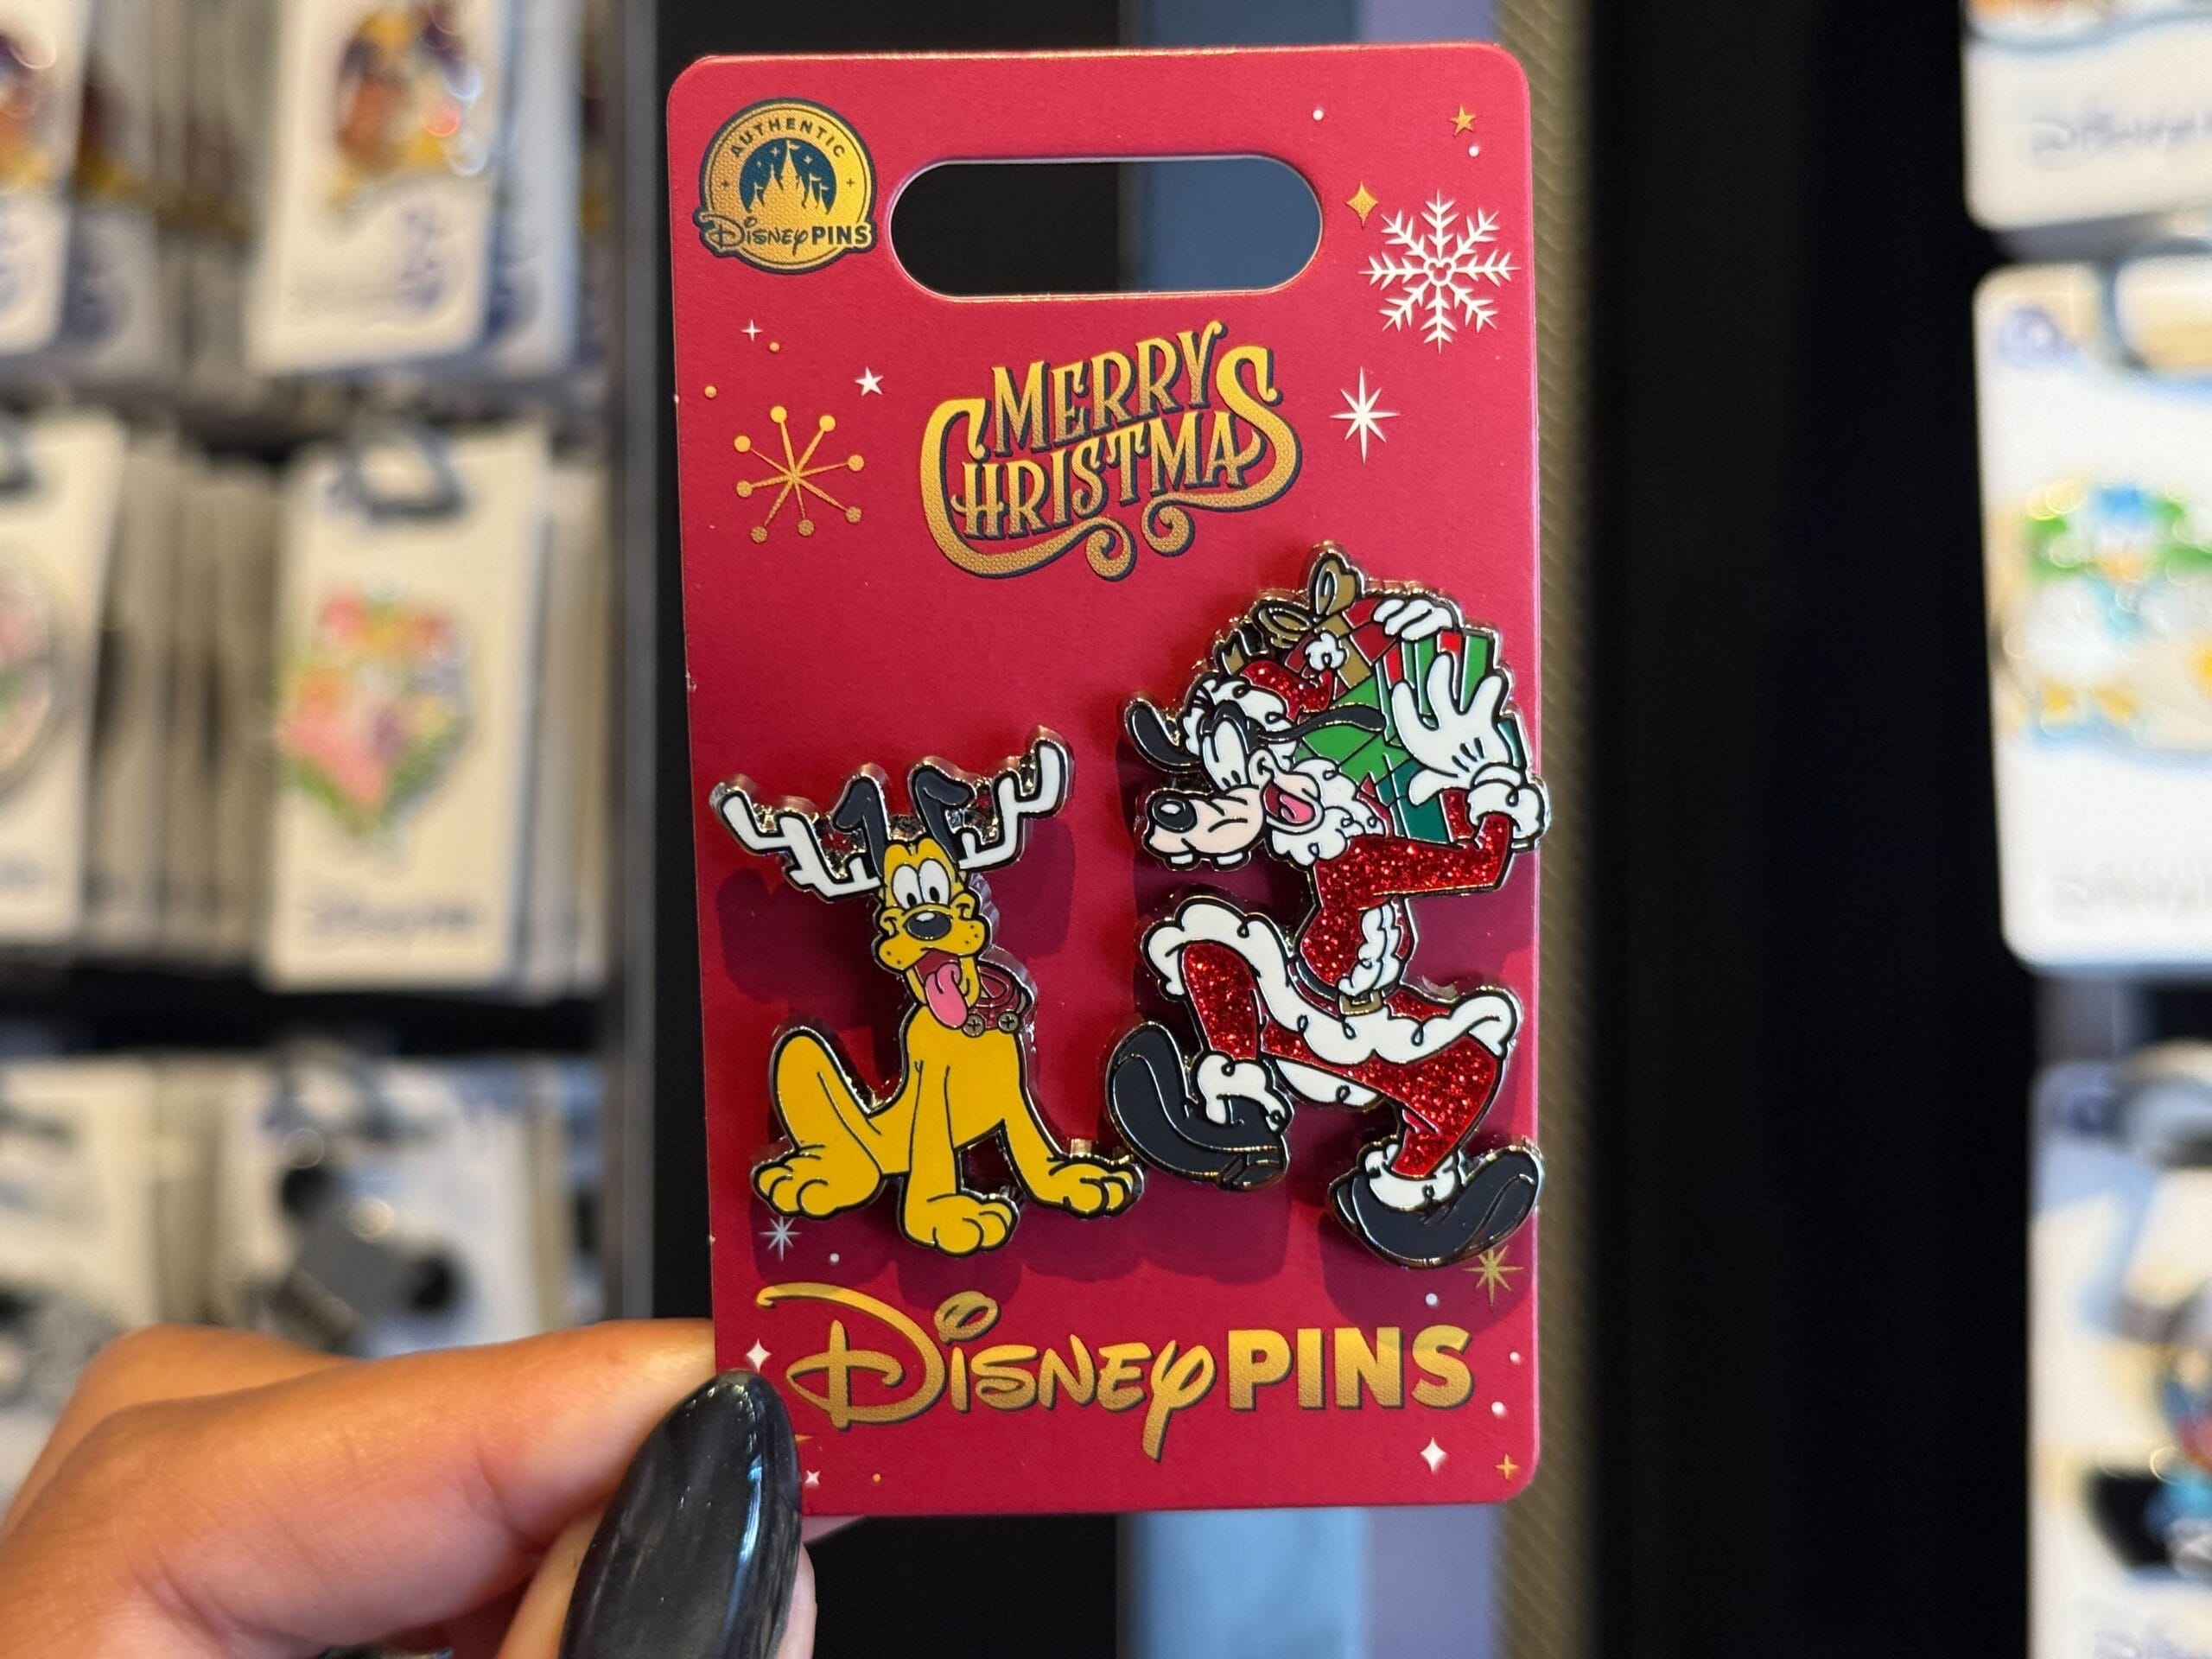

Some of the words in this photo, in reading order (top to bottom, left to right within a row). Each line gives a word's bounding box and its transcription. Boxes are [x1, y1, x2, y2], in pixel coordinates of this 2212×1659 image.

[731, 118, 846, 158] AUTHENTIC
[811, 225, 869, 245] PINS
[992, 321, 1227, 456] MERRY
[921, 346, 1301, 582] CHRISTMAS
[1228, 1325, 1474, 1410] PINS
